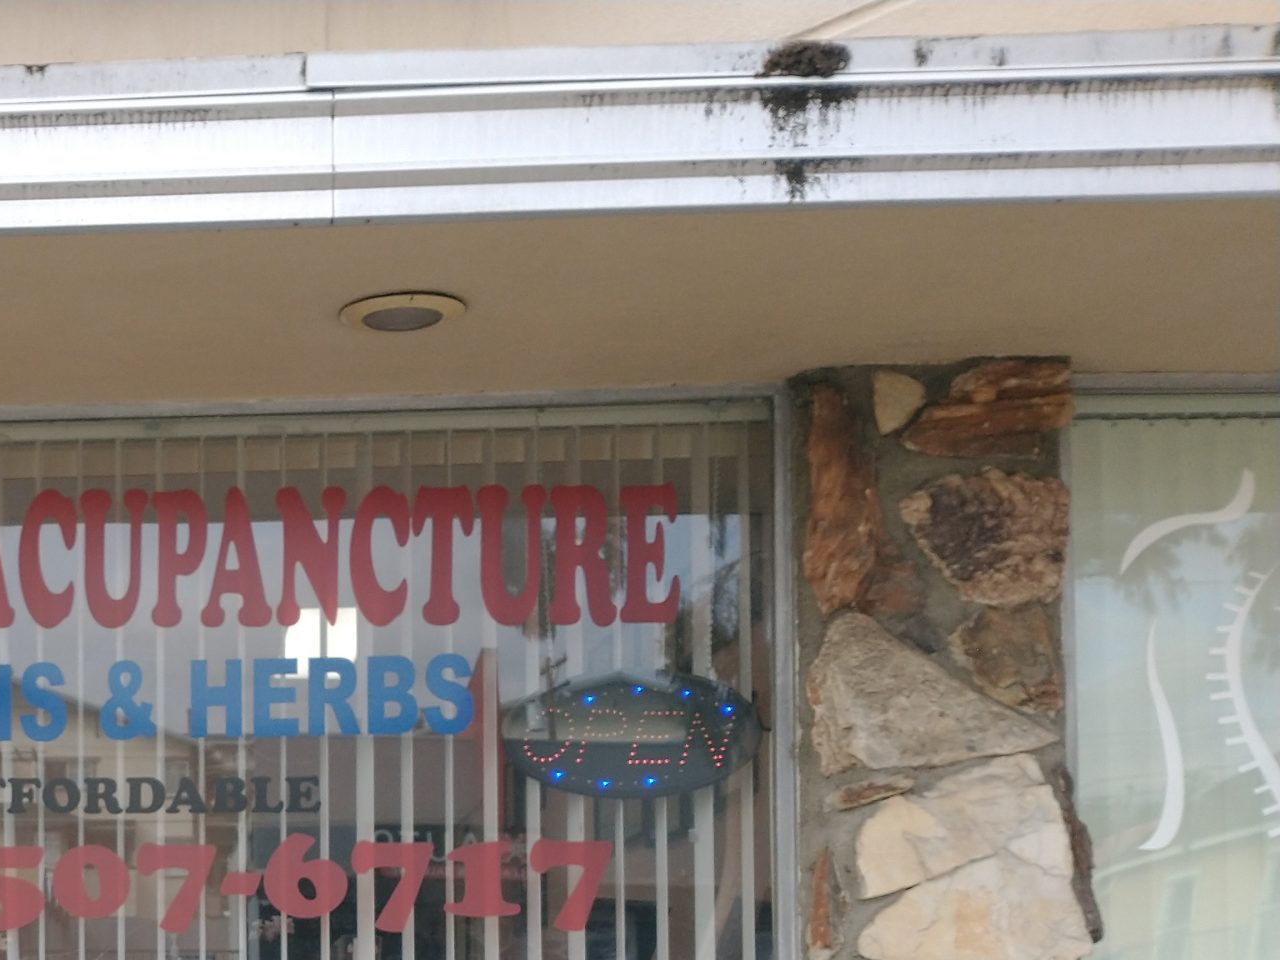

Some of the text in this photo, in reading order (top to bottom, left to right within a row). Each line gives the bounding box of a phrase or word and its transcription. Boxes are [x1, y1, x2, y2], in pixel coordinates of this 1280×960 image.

[100, 659, 158, 741] &
[189, 653, 476, 739] HERBS
[522, 706, 737, 767] OPEN
